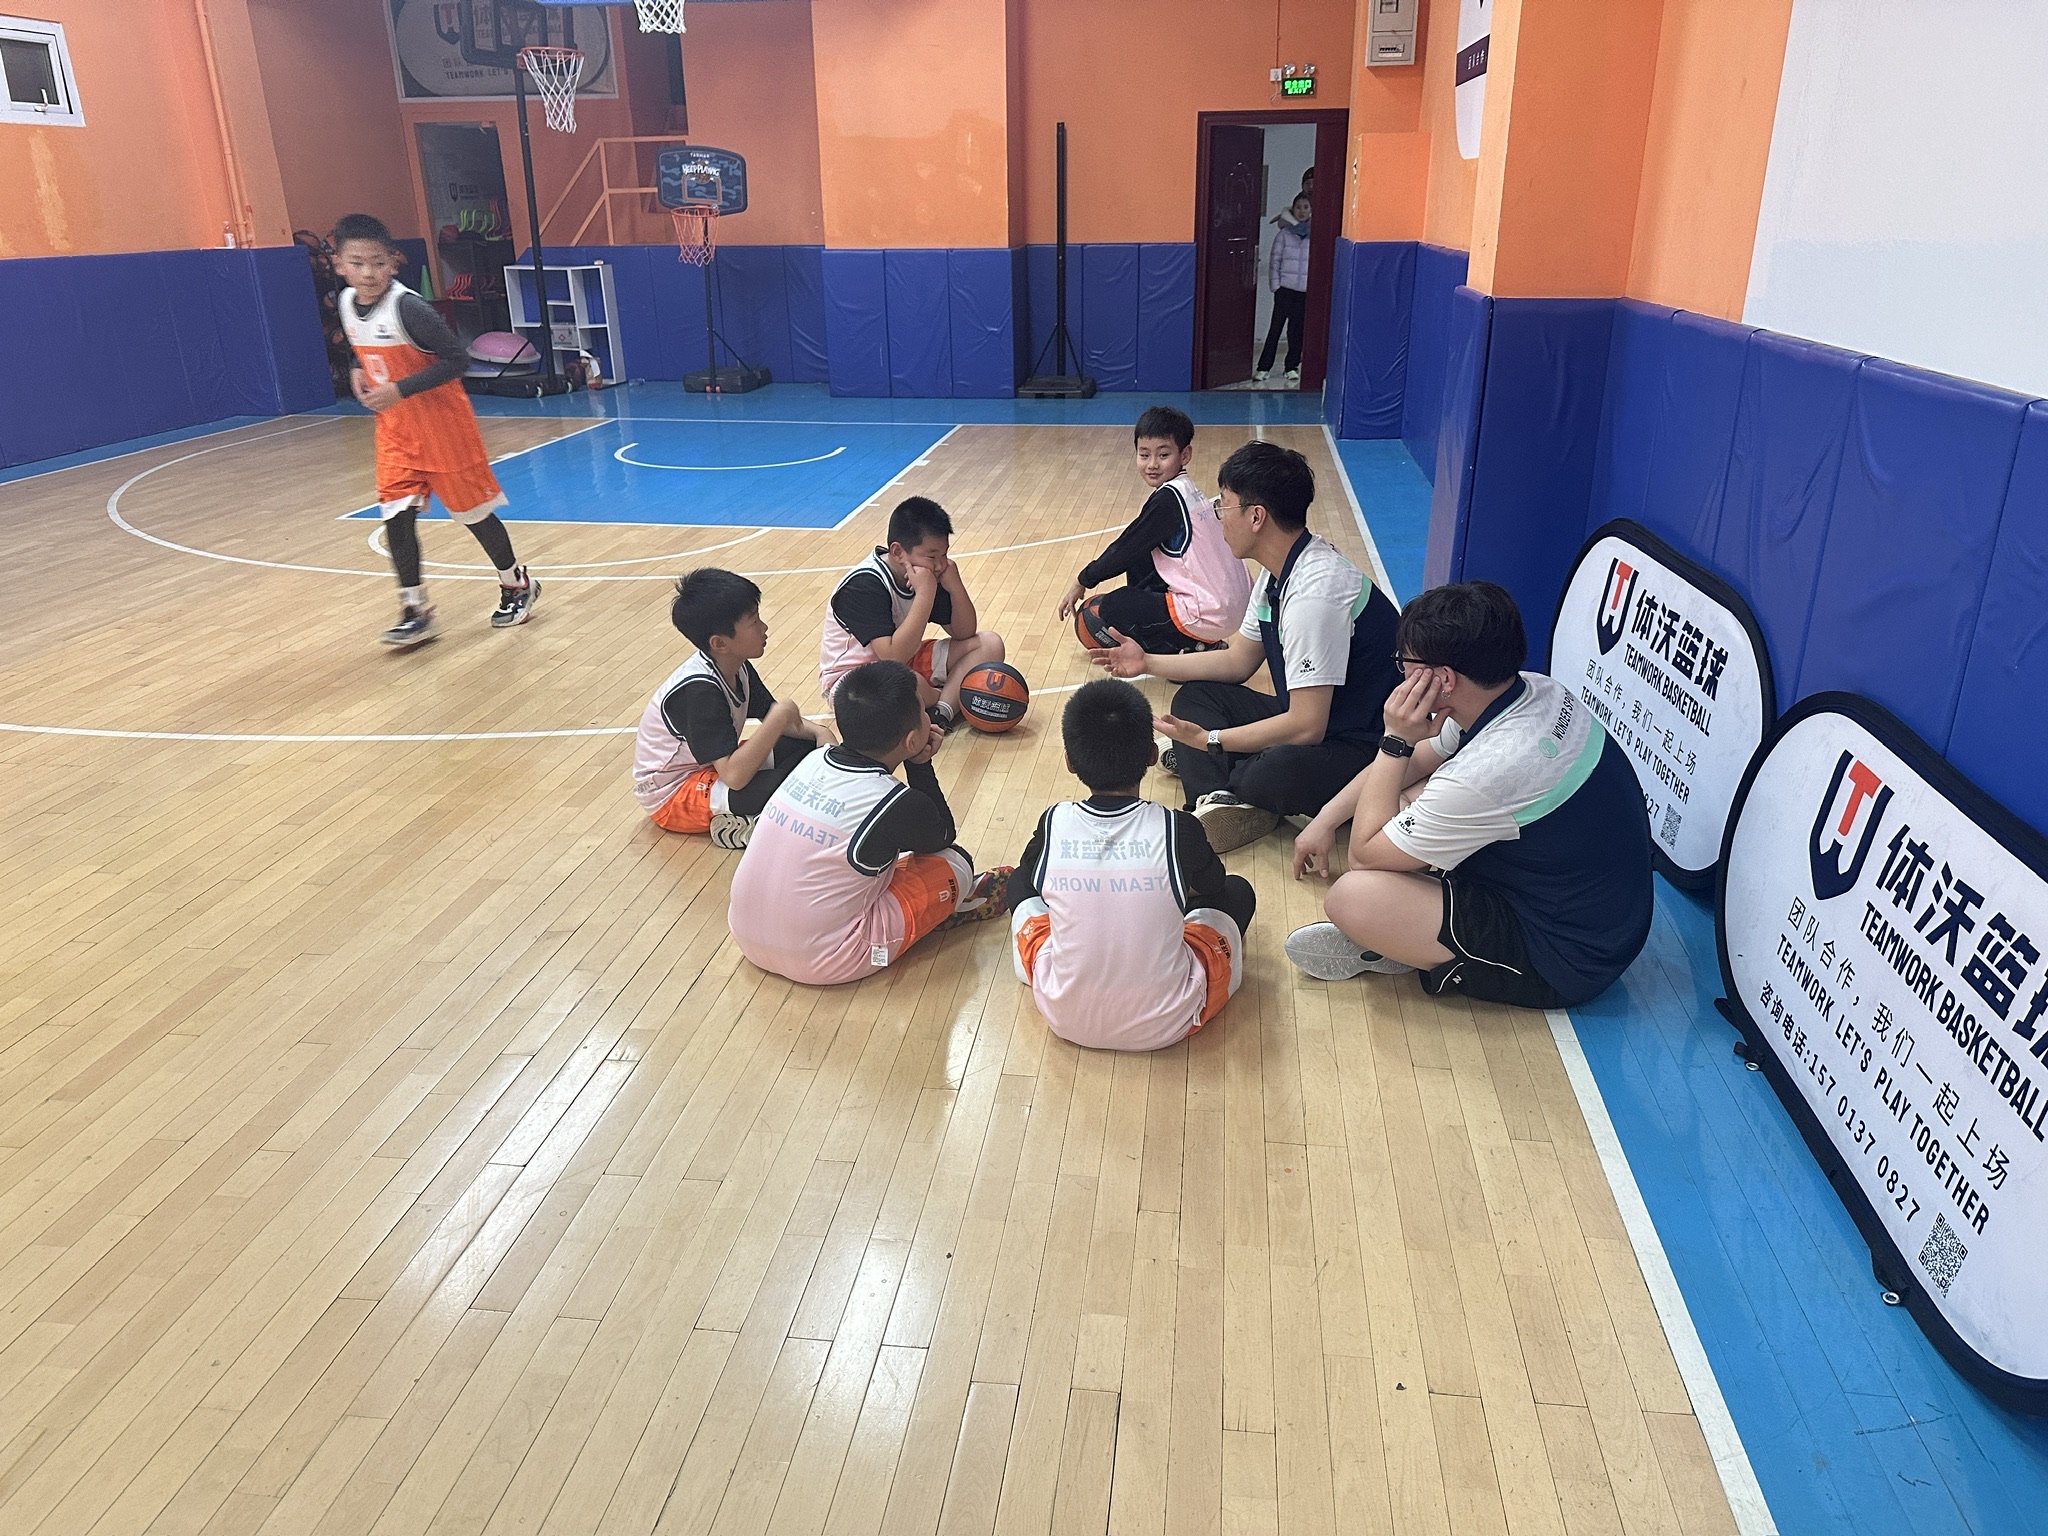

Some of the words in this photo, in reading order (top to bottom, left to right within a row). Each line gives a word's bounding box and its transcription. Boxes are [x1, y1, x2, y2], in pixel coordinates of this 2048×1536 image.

[1624, 642, 1664, 694] TEAMWORK
[1661, 674, 1712, 737] BASKETBALL
[1631, 589, 1729, 701] 体沃篮球
[1551, 707, 1572, 740] WONDER
[1580, 685, 1613, 727] TEAMWORK
[1613, 717, 1633, 747] LET'S
[1633, 737, 1653, 765] PLAY
[1652, 754, 1690, 805] TOGETHER
[1860, 900, 1943, 1013] TEAMWORK
[1935, 988, 2045, 1142] BASKETBALL
[1775, 933, 1835, 1022] TEAMWORK
[1835, 1014, 1873, 1072] LET'S
[1873, 1066, 1912, 1123] PLAY
[1909, 1112, 1990, 1235] TOGETHER
[1837, 1095, 1877, 1155] 0137
[1877, 1155, 1921, 1223] 0827
